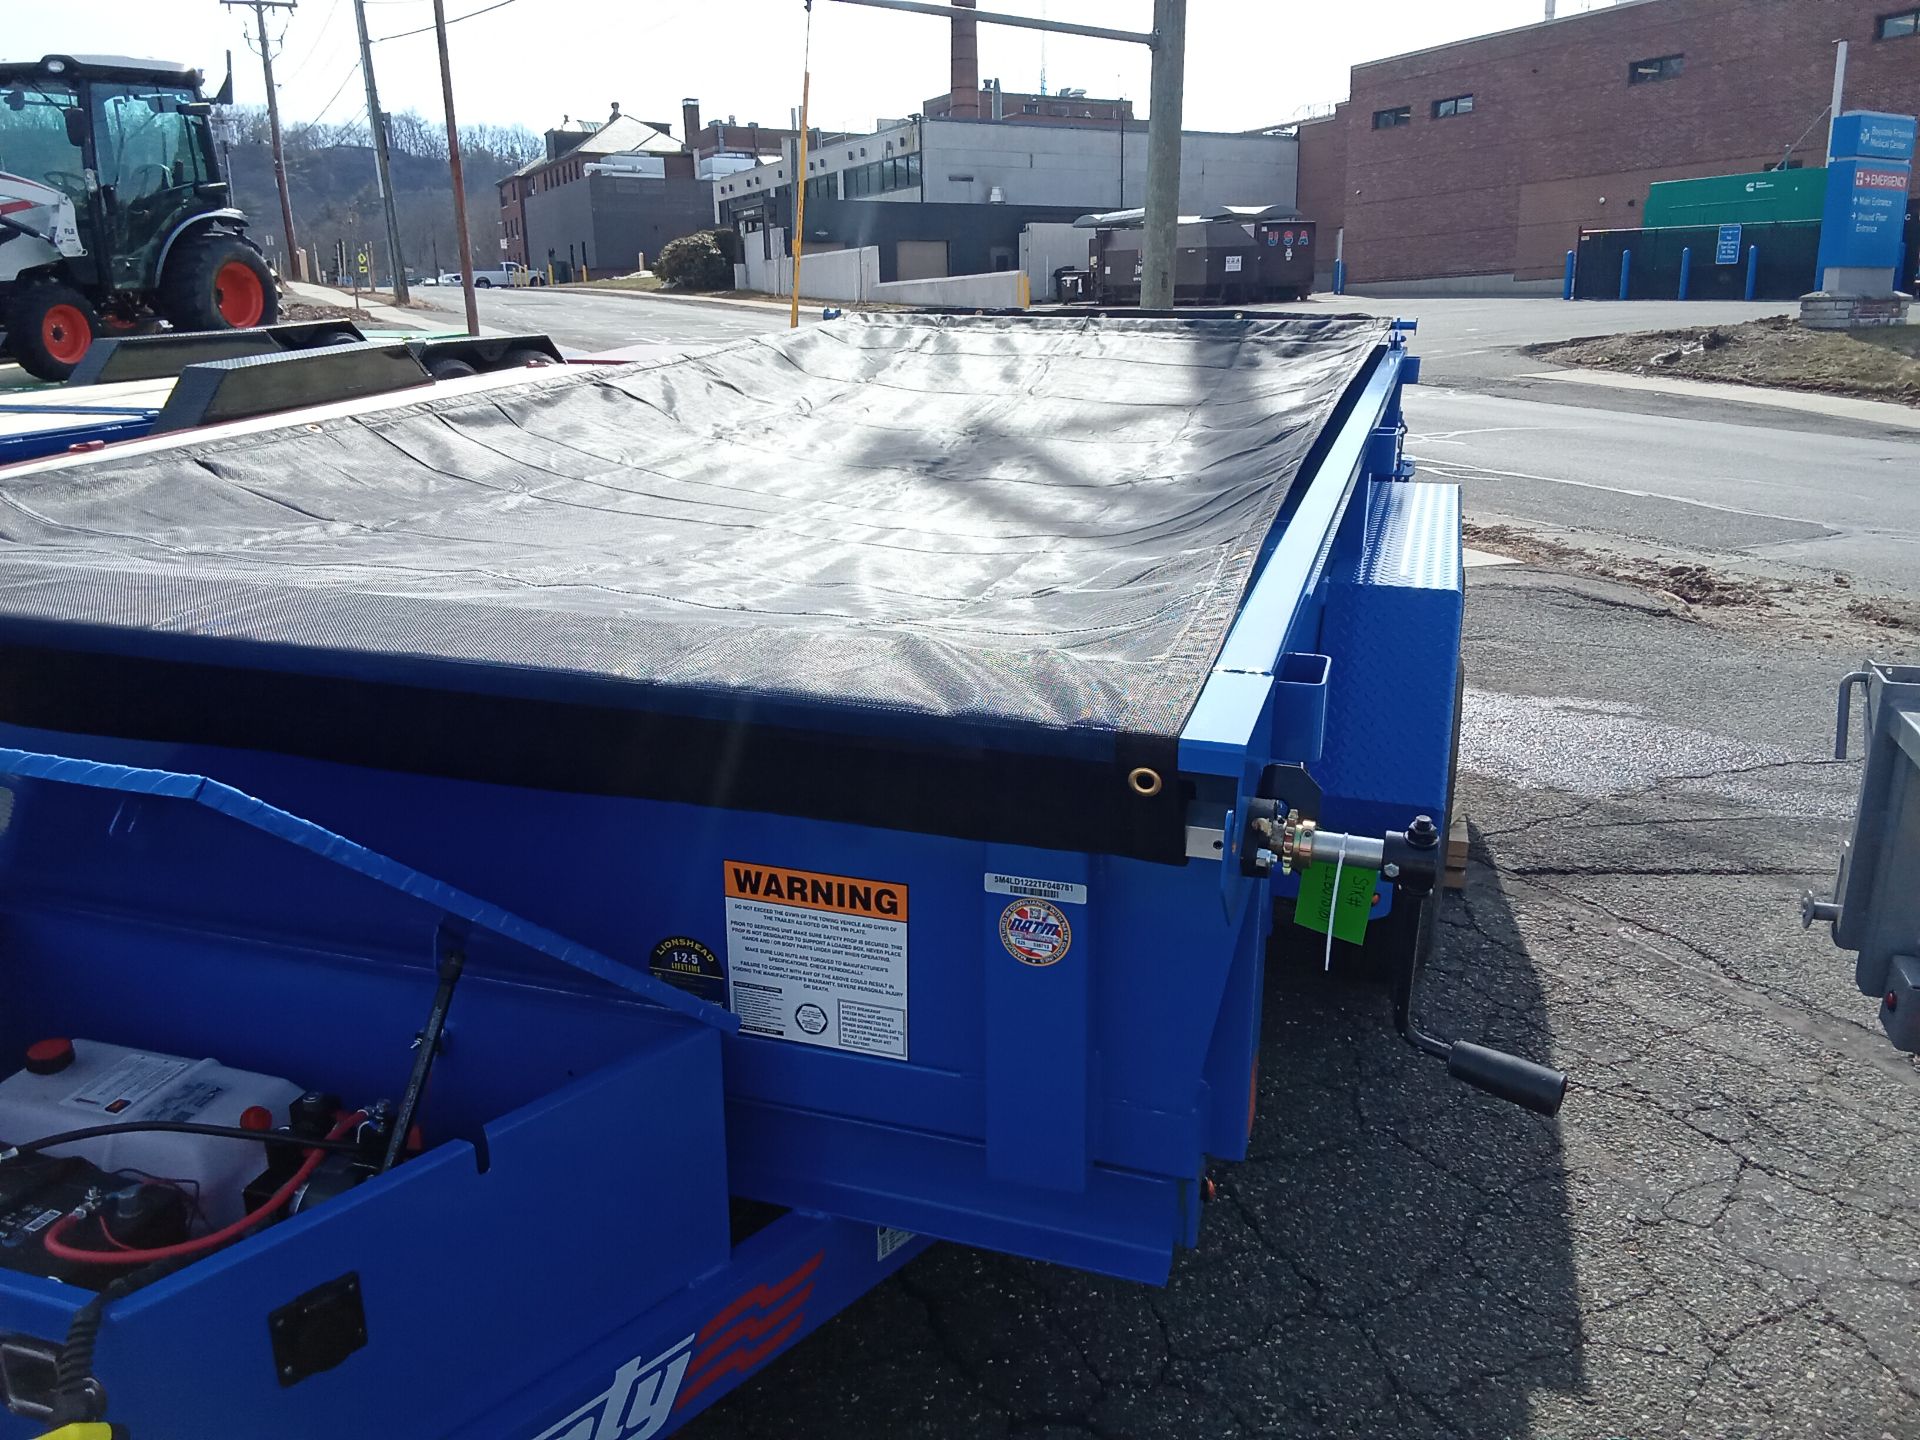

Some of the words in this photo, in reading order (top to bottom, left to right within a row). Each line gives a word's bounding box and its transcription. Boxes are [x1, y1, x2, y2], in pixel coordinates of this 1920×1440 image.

[1871, 174, 1907, 187] EMERGENCY
[732, 868, 898, 915] WARNING
[1345, 875, 1370, 908] STK#
[1010, 900, 1049, 911] COMPLIANCE
[743, 904, 753, 912] NOT
[819, 916, 839, 924] TOWING
[841, 919, 860, 927] VEHICLE
[754, 923, 780, 932] SERVICING
[823, 934, 842, 942] SAFETY
[656, 938, 714, 962] LIONSHEAD
[797, 943, 812, 951] PARTS
[803, 938, 825, 946] SUPPORT
[832, 942, 852, 950] LOADED
[866, 947, 883, 955] NEVER
[671, 962, 701, 973] LIFETIME
[810, 956, 834, 964] TORQUED
[769, 964, 789, 973] COMPLY
[832, 974, 849, 982] ABOVE
[850, 977, 868, 985] COULD
[869, 980, 888, 988] RESULT
[837, 982, 856, 990] SEVERE
[858, 986, 884, 995] PERSONAL
[886, 990, 903, 998] INJURY
